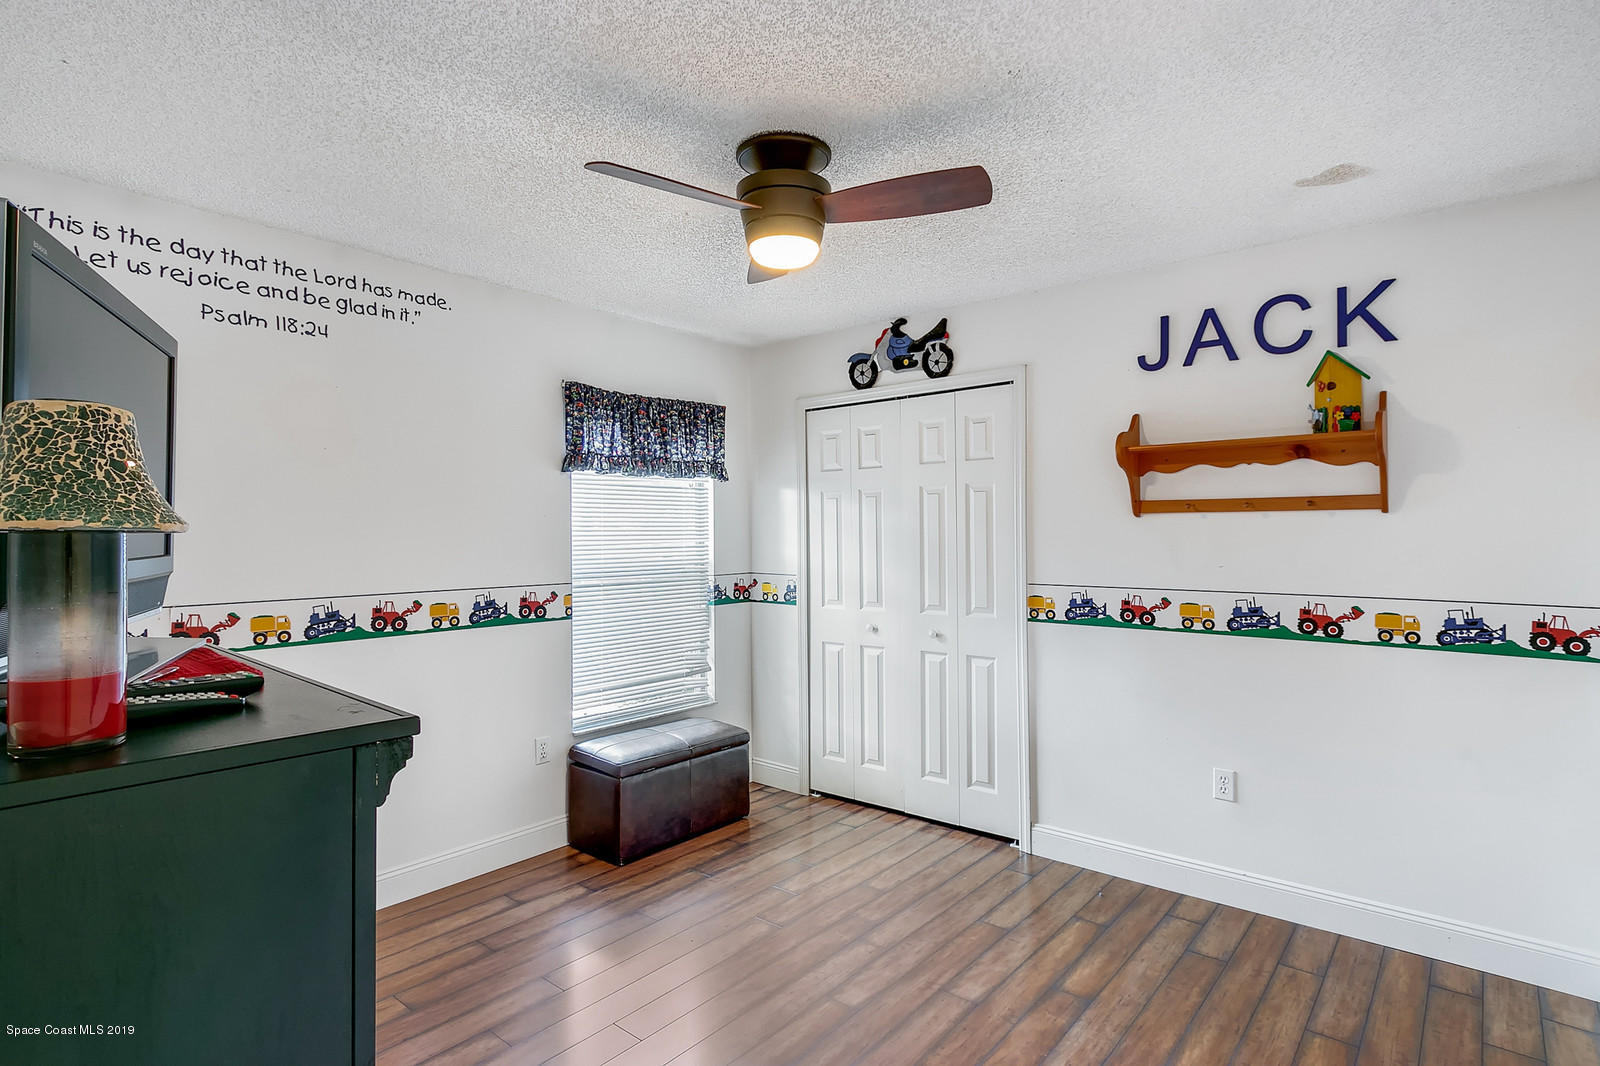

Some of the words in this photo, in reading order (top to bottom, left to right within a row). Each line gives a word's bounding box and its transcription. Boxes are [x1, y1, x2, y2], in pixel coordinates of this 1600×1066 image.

[93, 220, 110, 241] is
[117, 225, 162, 253] the
[169, 238, 215, 265] day
[220, 247, 268, 272] that
[272, 258, 309, 282] the
[313, 268, 357, 290] Lord
[362, 277, 393, 298] has
[397, 288, 452, 311] made.
[126, 258, 152, 276] us
[159, 265, 251, 295] rejoice
[256, 285, 299, 302] and
[302, 286, 331, 310] be
[335, 297, 378, 317] glad
[380, 303, 396, 320] in
[200, 303, 268, 329] Psalm
[275, 314, 329, 338] 118:24
[1137, 278, 1399, 372] JACK
